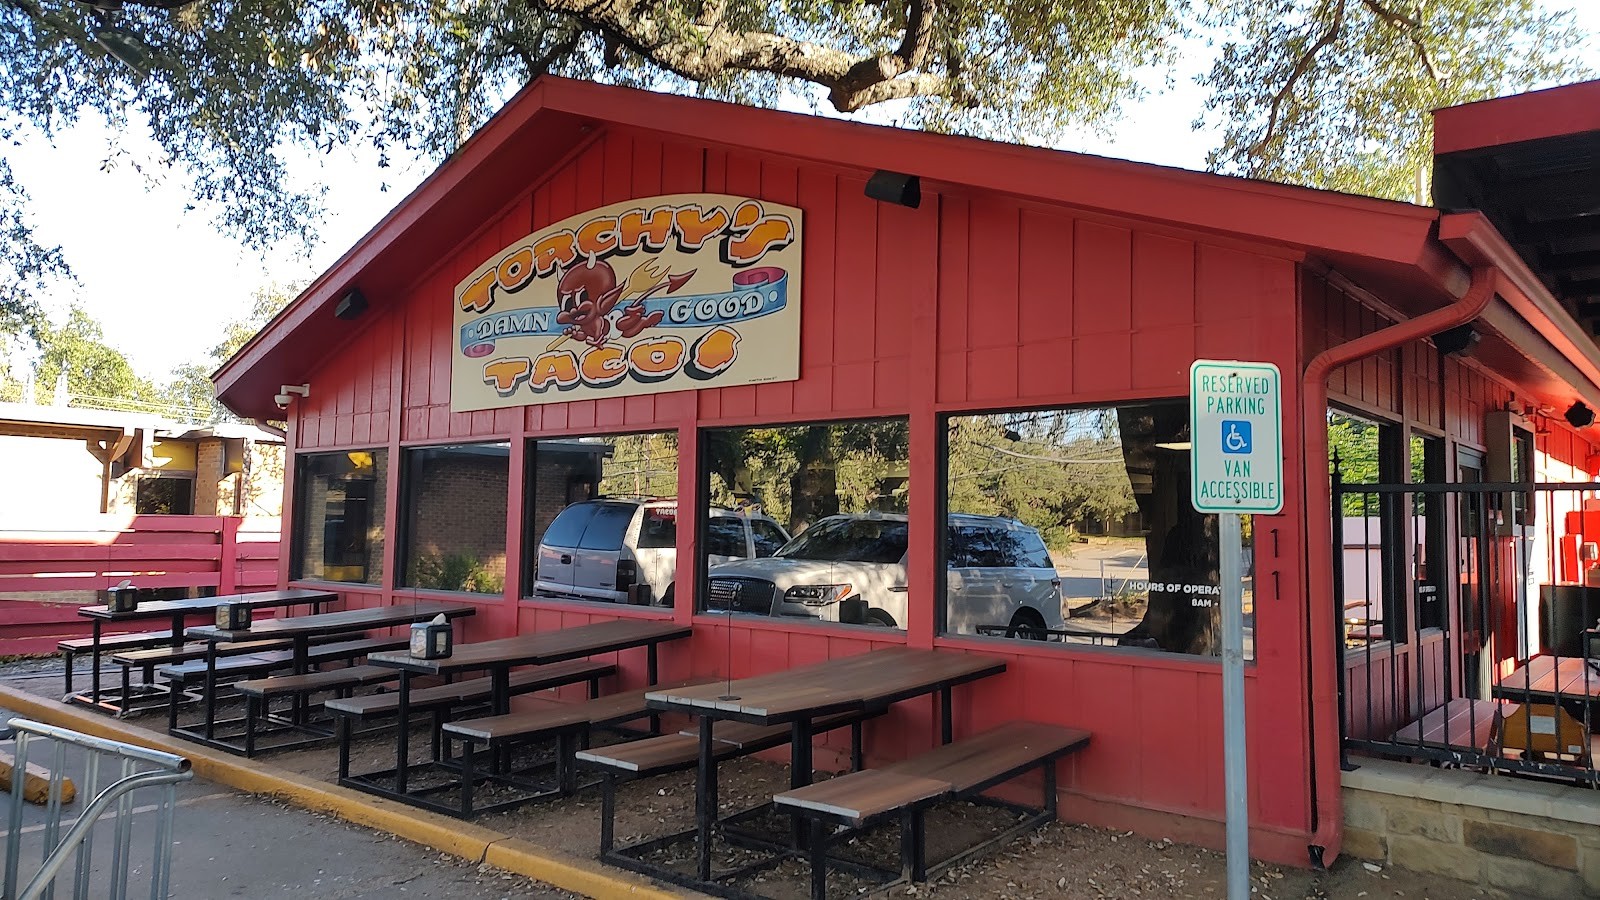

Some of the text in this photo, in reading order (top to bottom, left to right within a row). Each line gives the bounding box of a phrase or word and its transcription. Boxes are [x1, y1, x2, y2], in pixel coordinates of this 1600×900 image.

[458, 200, 795, 313] TORCHY'S
[477, 290, 765, 340] DAMN GOOD
[1202, 375, 1269, 395] RESERVED
[1207, 396, 1265, 415] PARKING
[1224, 460, 1250, 478] VAN
[1200, 481, 1275, 499] ACCESSIBLE
[1129, 581, 1222, 596] HOURS OF OPERA
[1191, 598, 1212, 608] 8AM
